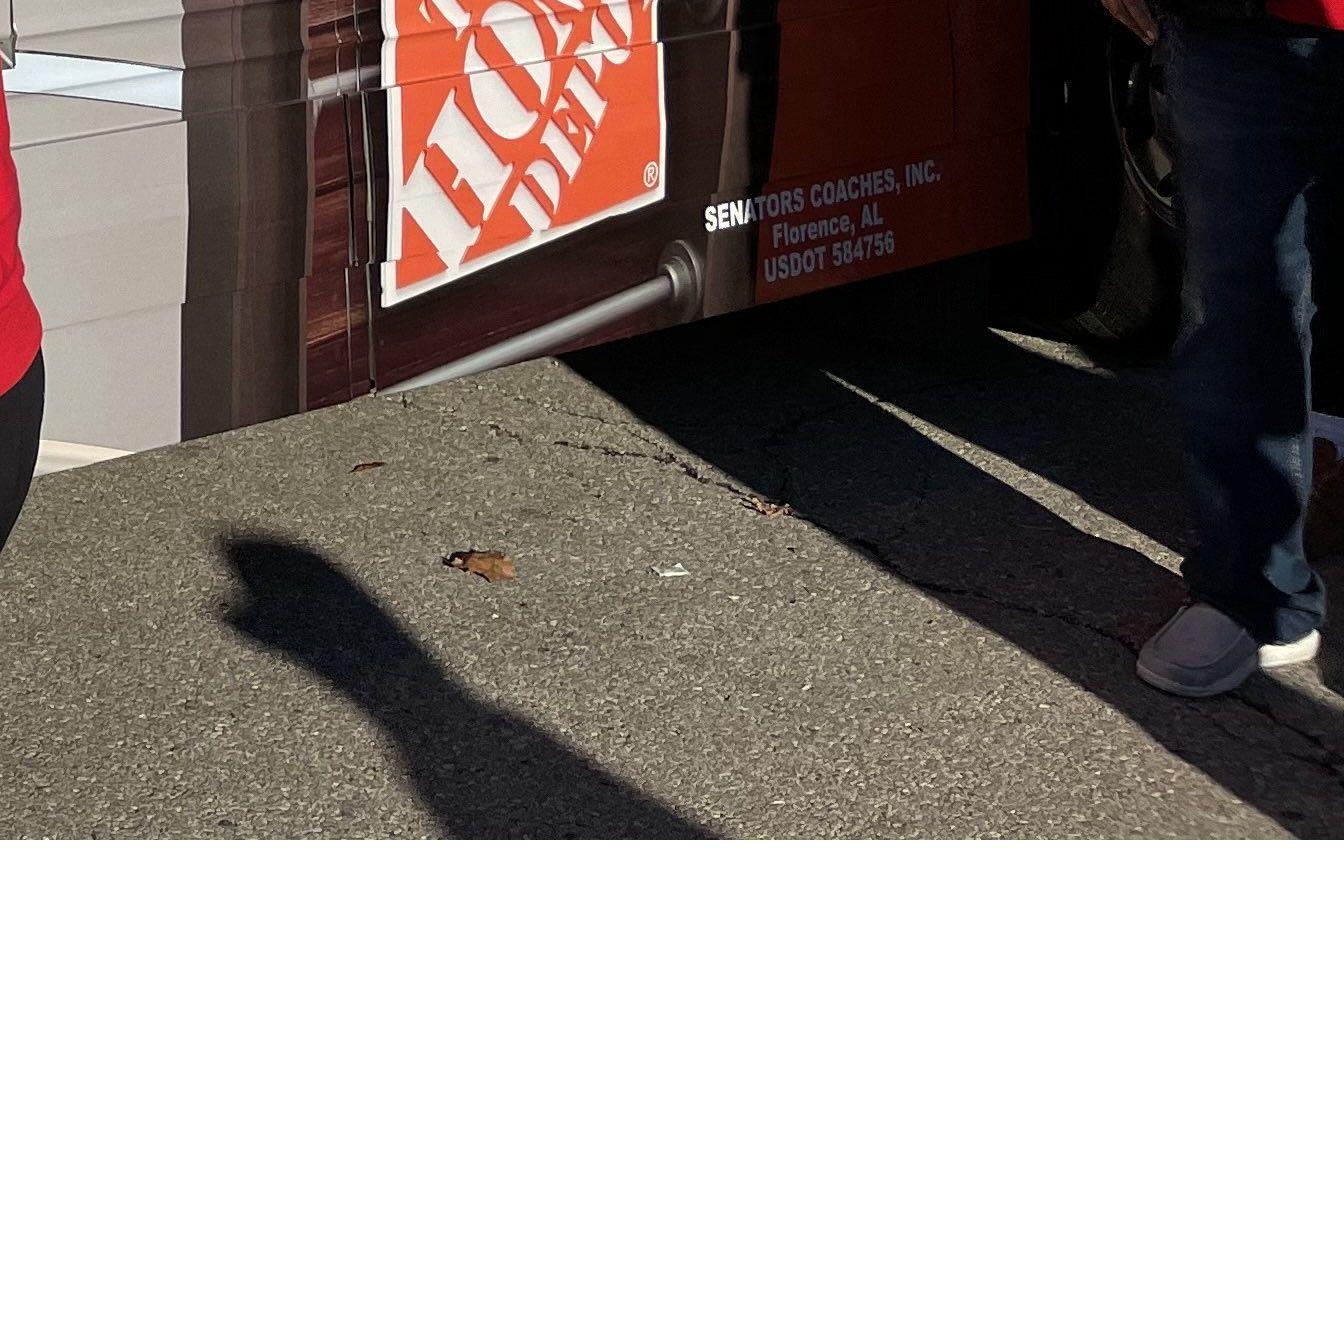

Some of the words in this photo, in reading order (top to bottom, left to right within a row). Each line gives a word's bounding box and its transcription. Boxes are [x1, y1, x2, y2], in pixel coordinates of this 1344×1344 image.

[704, 187, 805, 233] SENATORS
[809, 167, 901, 207] COACHES,
[905, 159, 942, 187] INC.
[772, 213, 856, 249] Florence,
[860, 201, 884, 229] AL
[764, 244, 827, 283] USDOT
[831, 230, 895, 267] 584756
